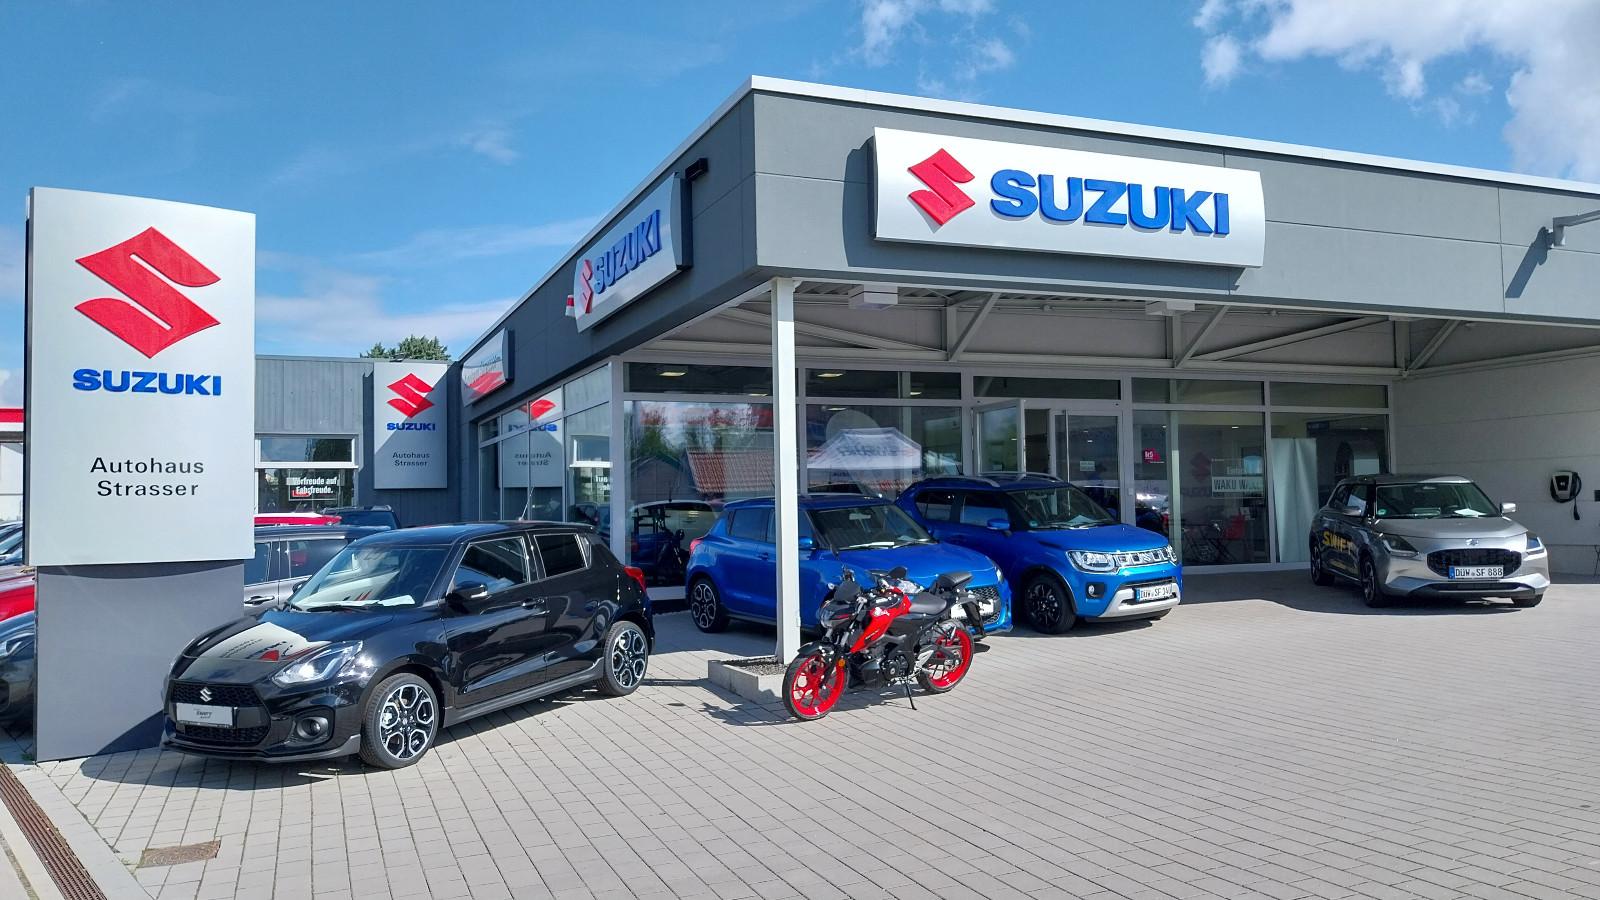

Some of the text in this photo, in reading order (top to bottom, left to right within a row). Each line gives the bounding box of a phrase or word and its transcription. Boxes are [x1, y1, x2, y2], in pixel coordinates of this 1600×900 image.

[990, 169, 1230, 236] SUZUKI
[594, 209, 662, 294] SUZUKI
[73, 368, 221, 396] SUZUKI
[386, 422, 436, 431] SUZUKI
[90, 457, 204, 474] Autohaus
[97, 480, 199, 497] Strasser
[1214, 479, 1237, 490] WAKU
[1476, 568, 1486, 577] SF
[1487, 567, 1503, 577] 888
